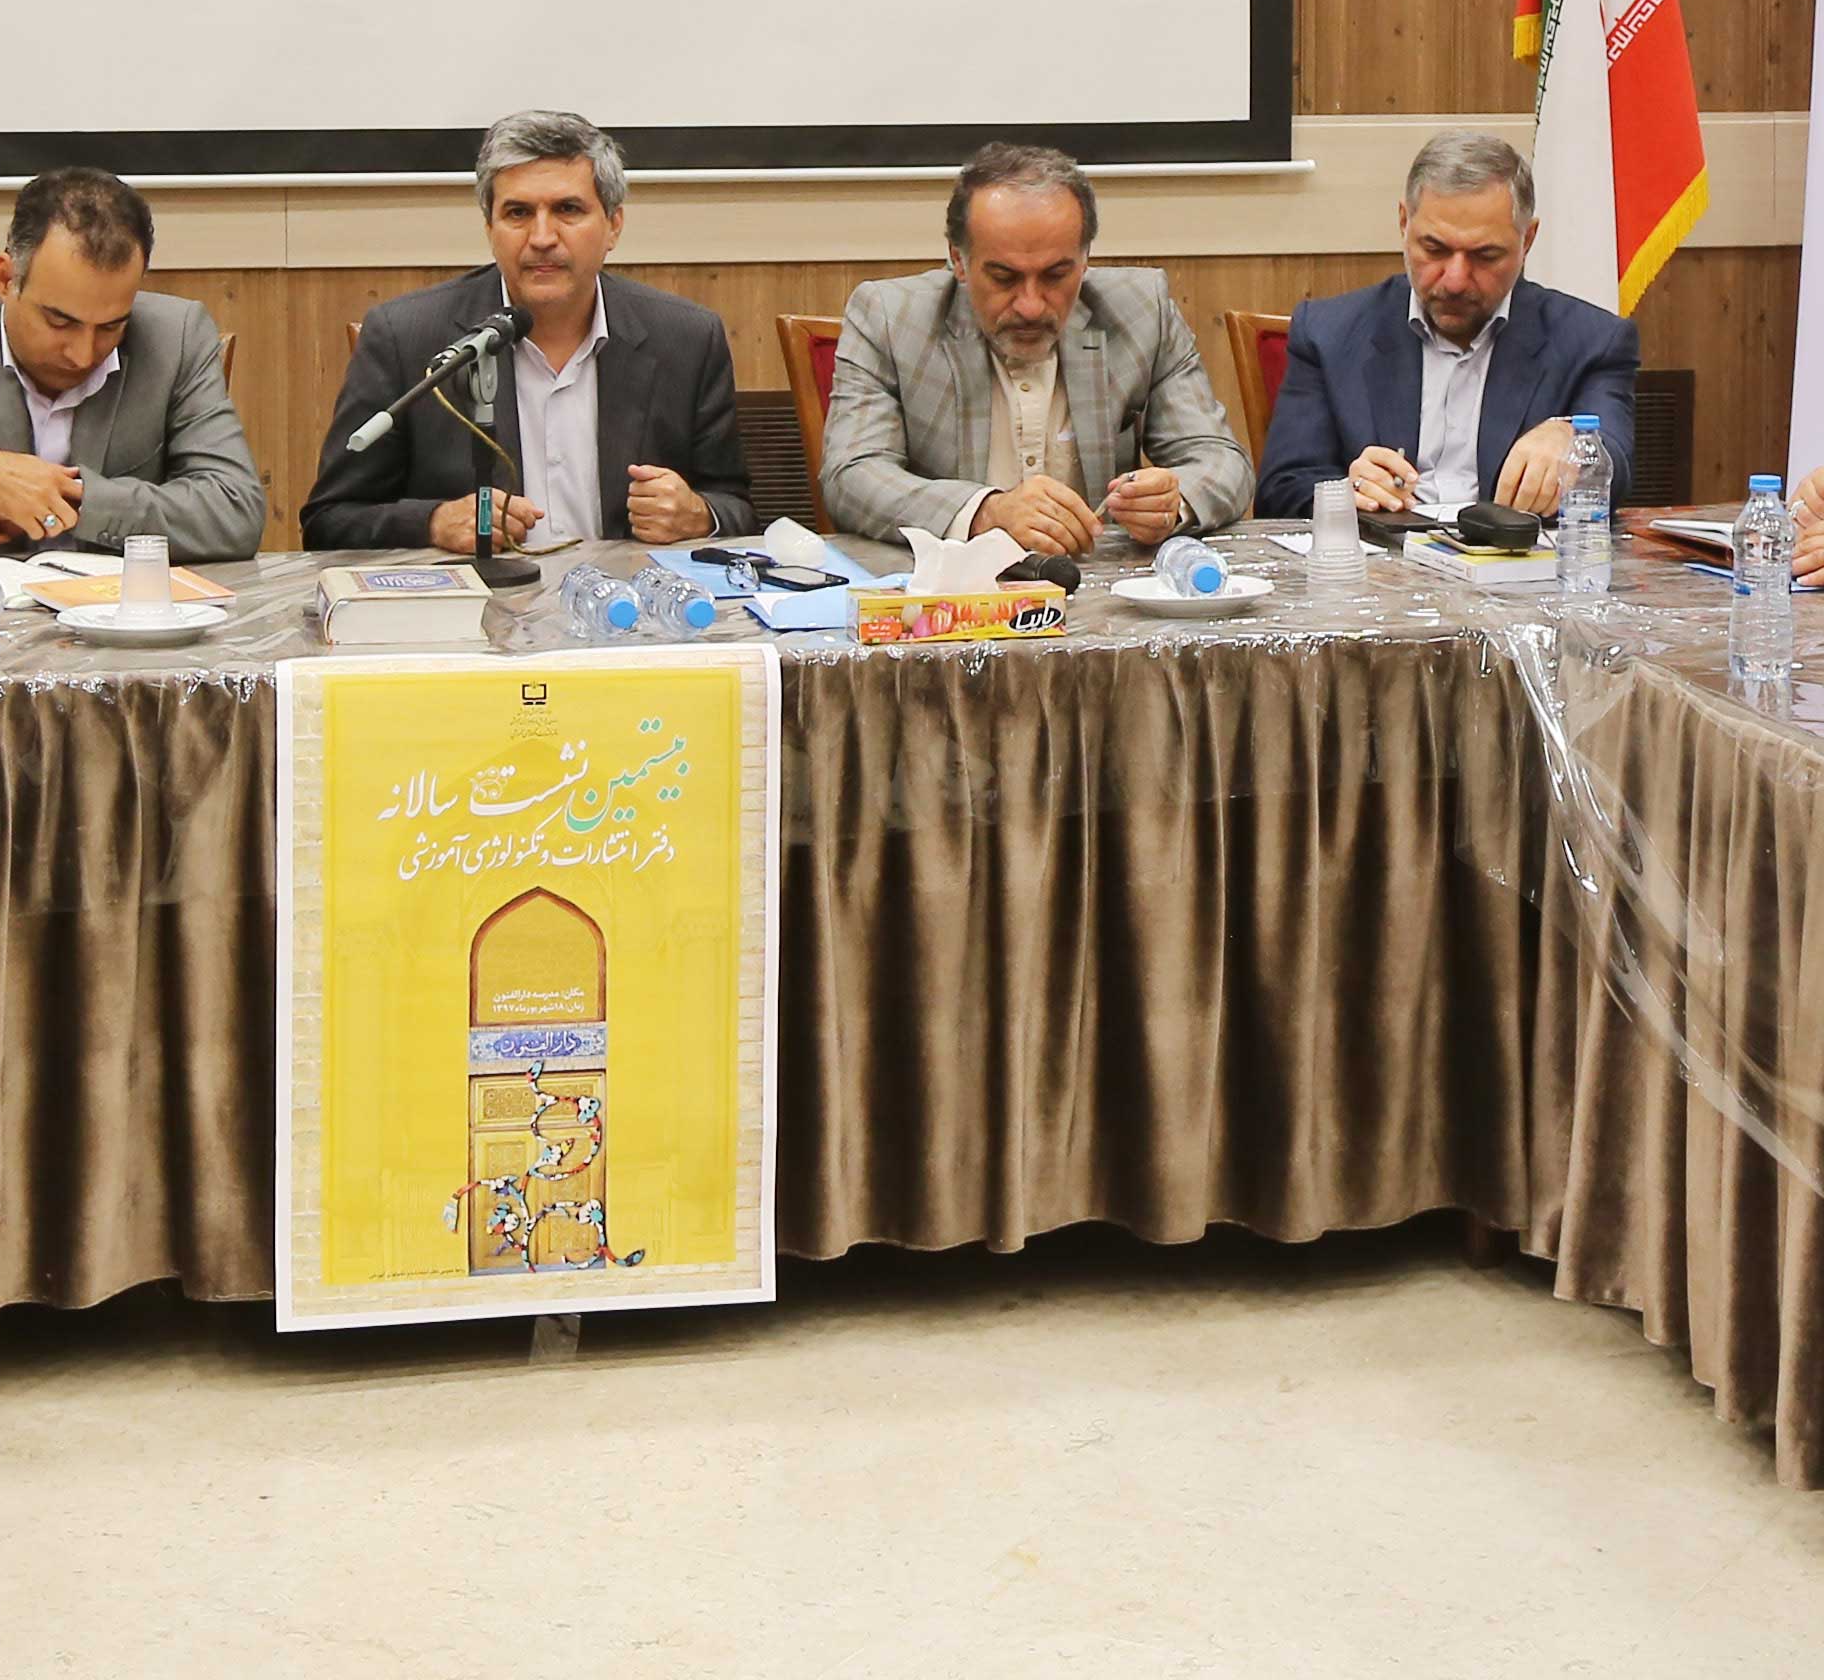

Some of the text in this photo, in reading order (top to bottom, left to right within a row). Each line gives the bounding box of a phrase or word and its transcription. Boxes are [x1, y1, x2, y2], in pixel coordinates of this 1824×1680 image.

[377, 719, 689, 834] بیستمین نشست سالانه
[398, 833, 470, 880] آموزشی
[633, 824, 675, 872] دفتر
